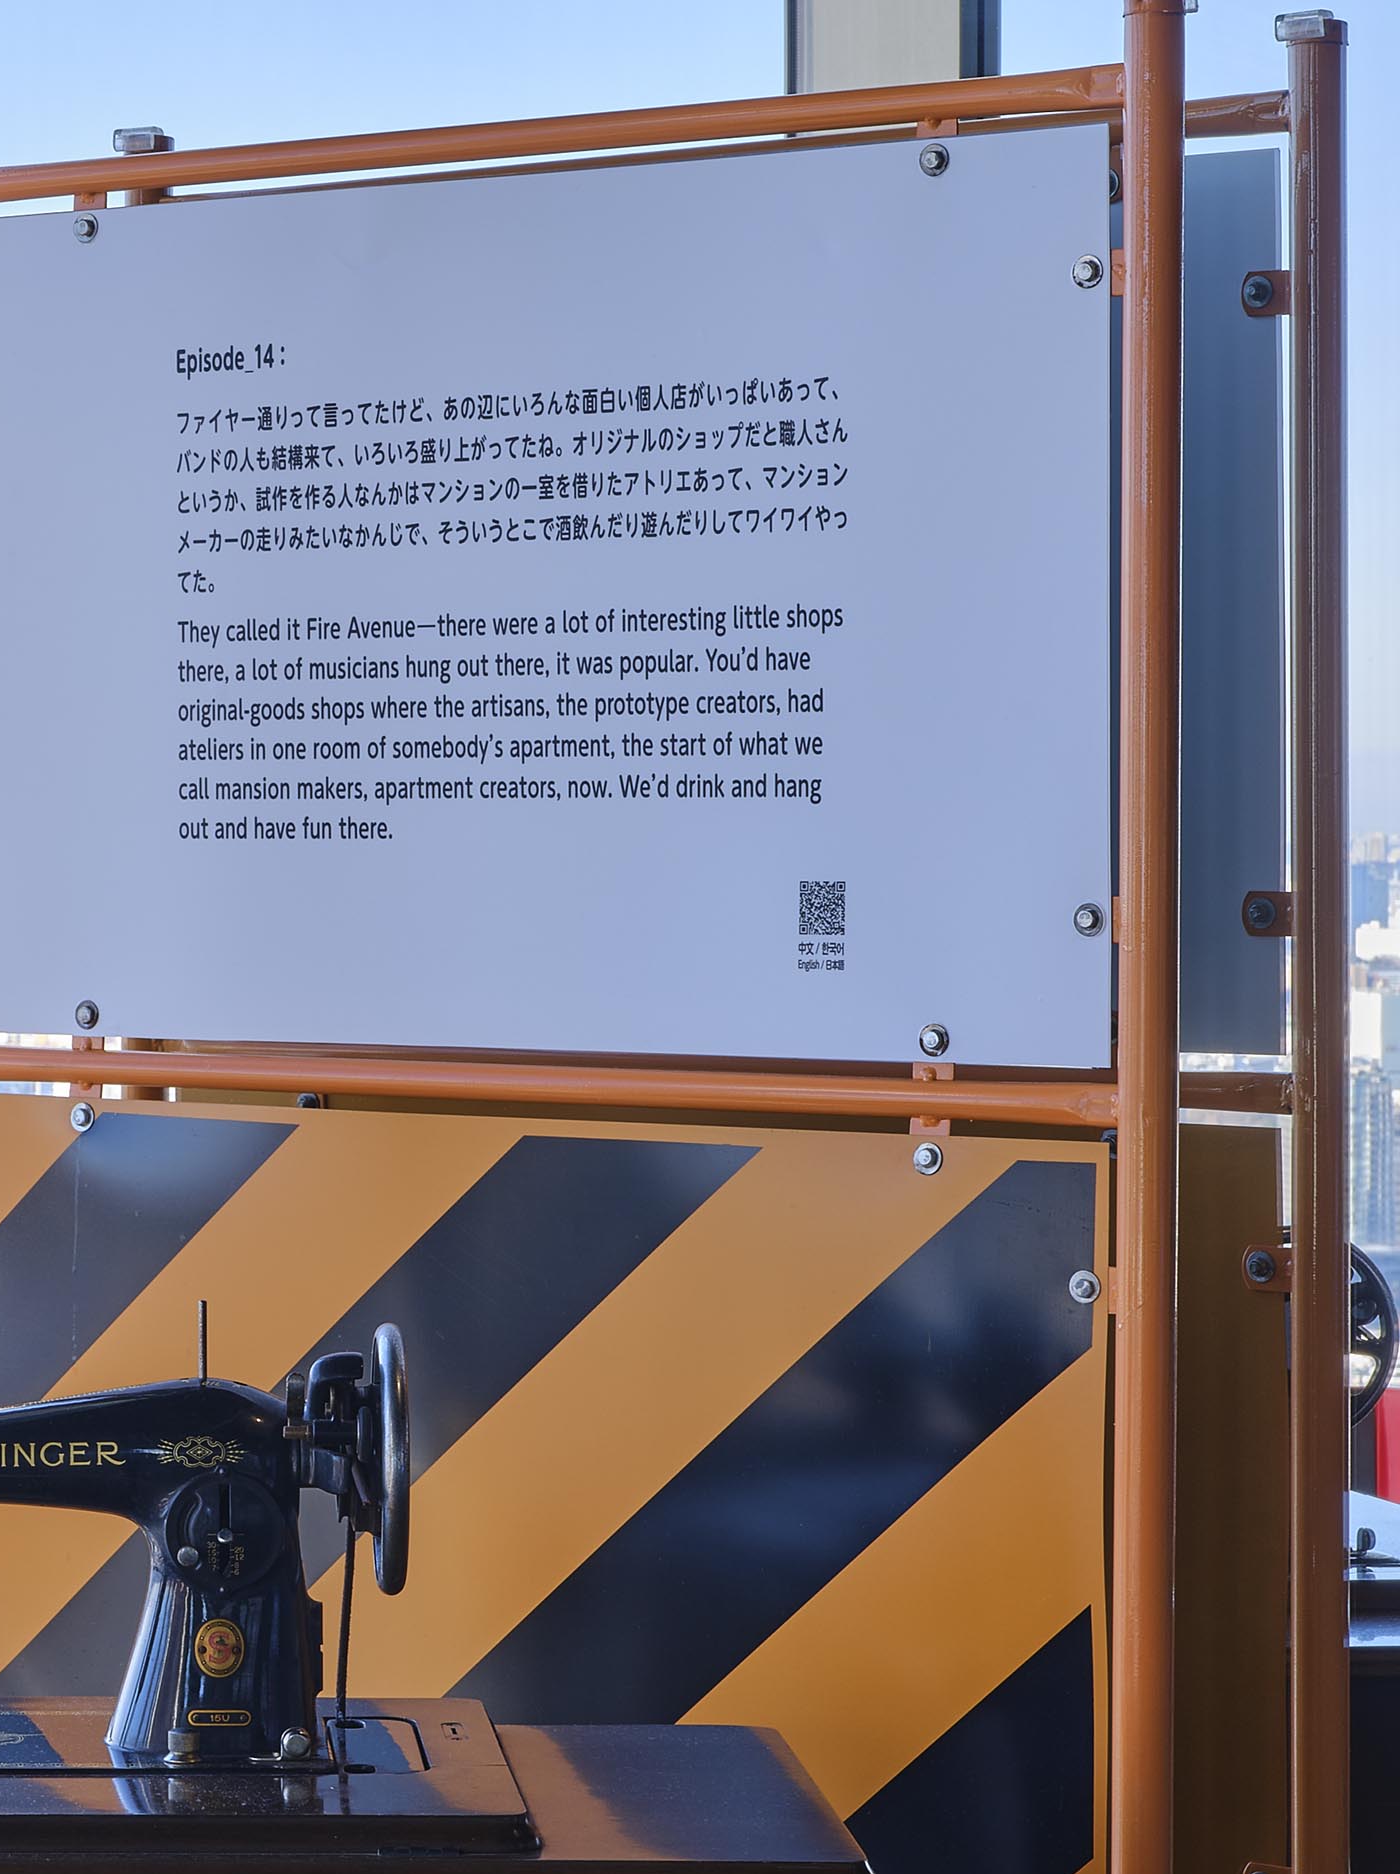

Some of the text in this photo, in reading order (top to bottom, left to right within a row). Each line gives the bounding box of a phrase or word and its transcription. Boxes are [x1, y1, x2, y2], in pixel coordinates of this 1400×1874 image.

[178, 570, 214, 593] てた。
[178, 620, 220, 648] They
[226, 618, 279, 641] called
[288, 618, 300, 640] it
[307, 617, 340, 640] Fire
[493, 617, 538, 635] were
[545, 617, 555, 634] a
[563, 610, 588, 633] lot
[596, 609, 615, 633] of
[622, 606, 726, 637] interesting
[734, 604, 779, 629] little
[787, 603, 843, 634] shops
[178, 646, 810, 684] there, a lot of musicians hung out there, it was popular. You’d have
[179, 688, 823, 727] original-goods shops where the artisans, the prototype creators, had
[179, 731, 823, 764] ateliers in one room of somebody’s apartment, the start of what we
[179, 773, 822, 805] call mansion makers, apartment creators, now. We’d drink and hang
[179, 816, 392, 839] out and have fun there.
[798, 941, 814, 955] 中文
[822, 942, 845, 956] 한국어
[798, 959, 820, 972] English
